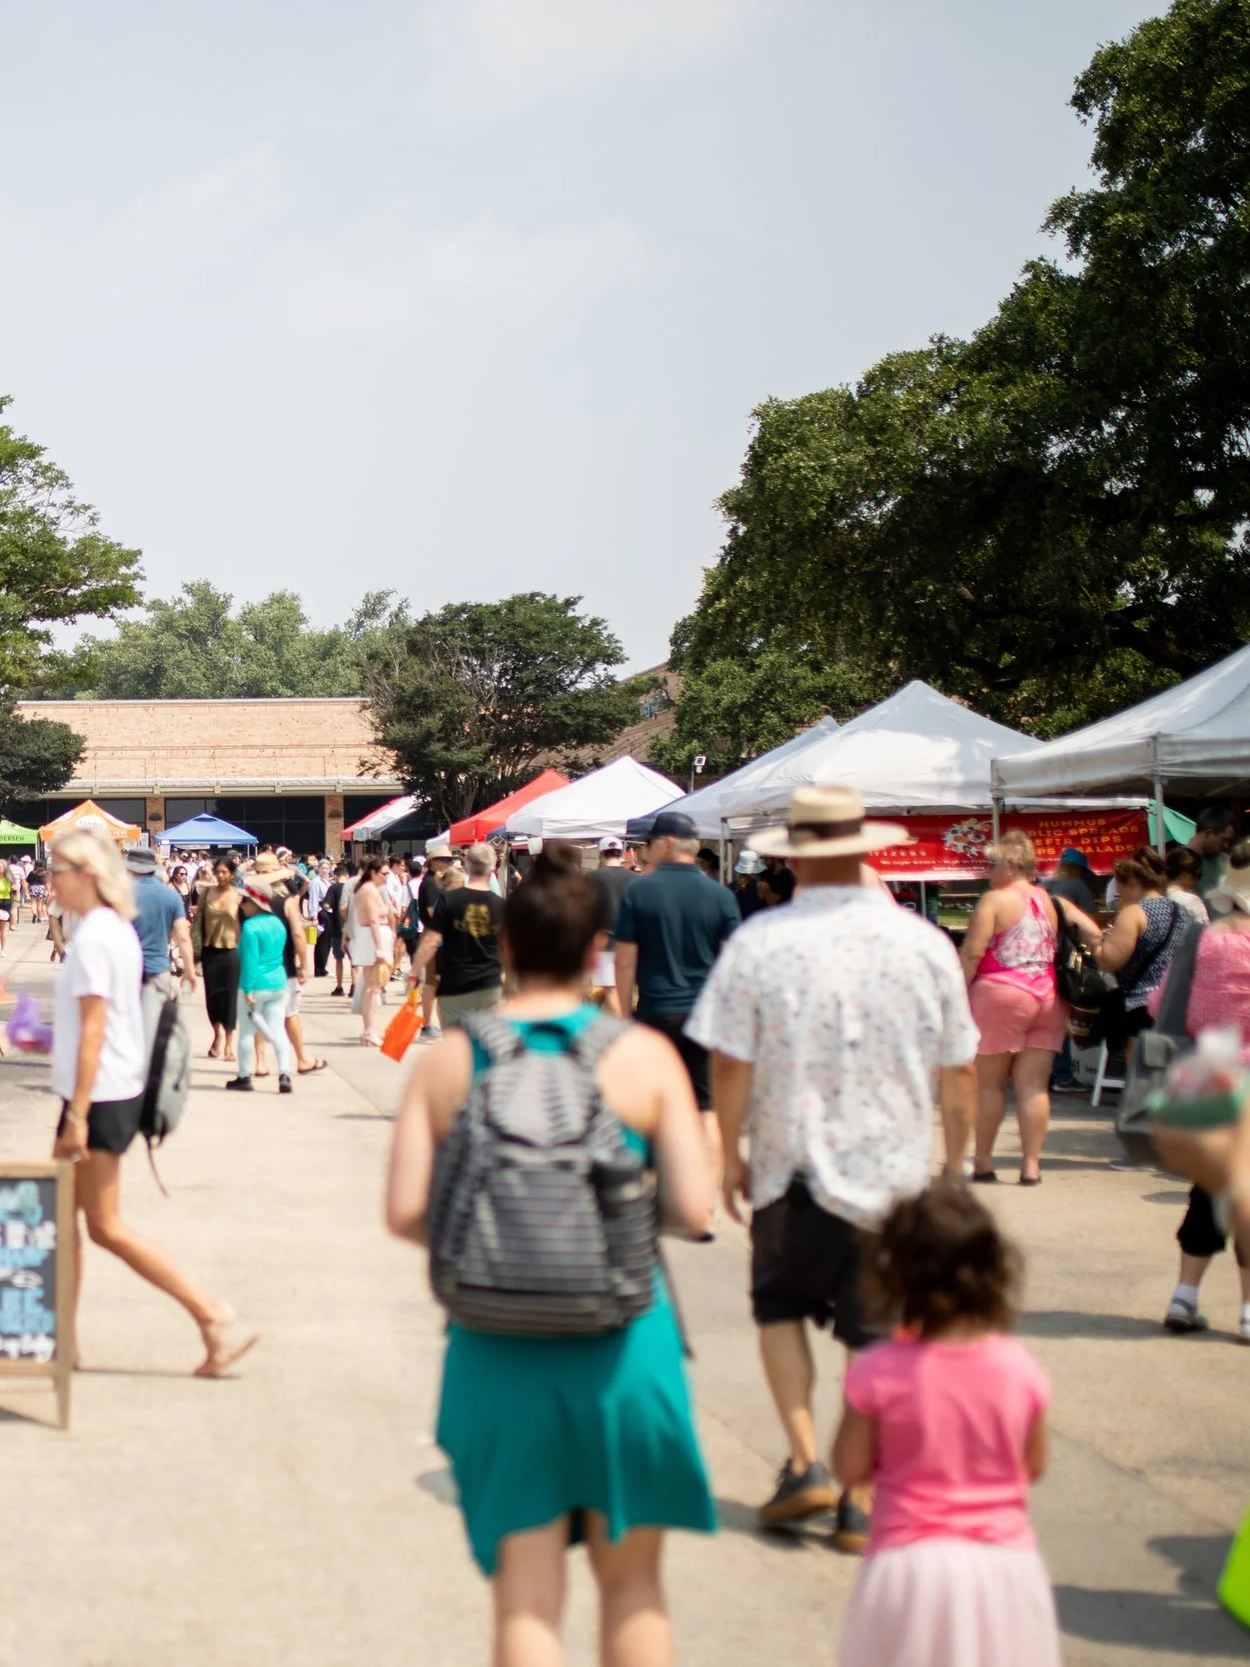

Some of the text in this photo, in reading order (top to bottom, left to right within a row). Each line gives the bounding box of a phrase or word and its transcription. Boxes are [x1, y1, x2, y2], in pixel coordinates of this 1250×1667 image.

[1039, 819, 1106, 828] HUMMUS
[1068, 826, 1139, 836] SPREADS
[1035, 835, 1122, 846] EFIR DIPS
